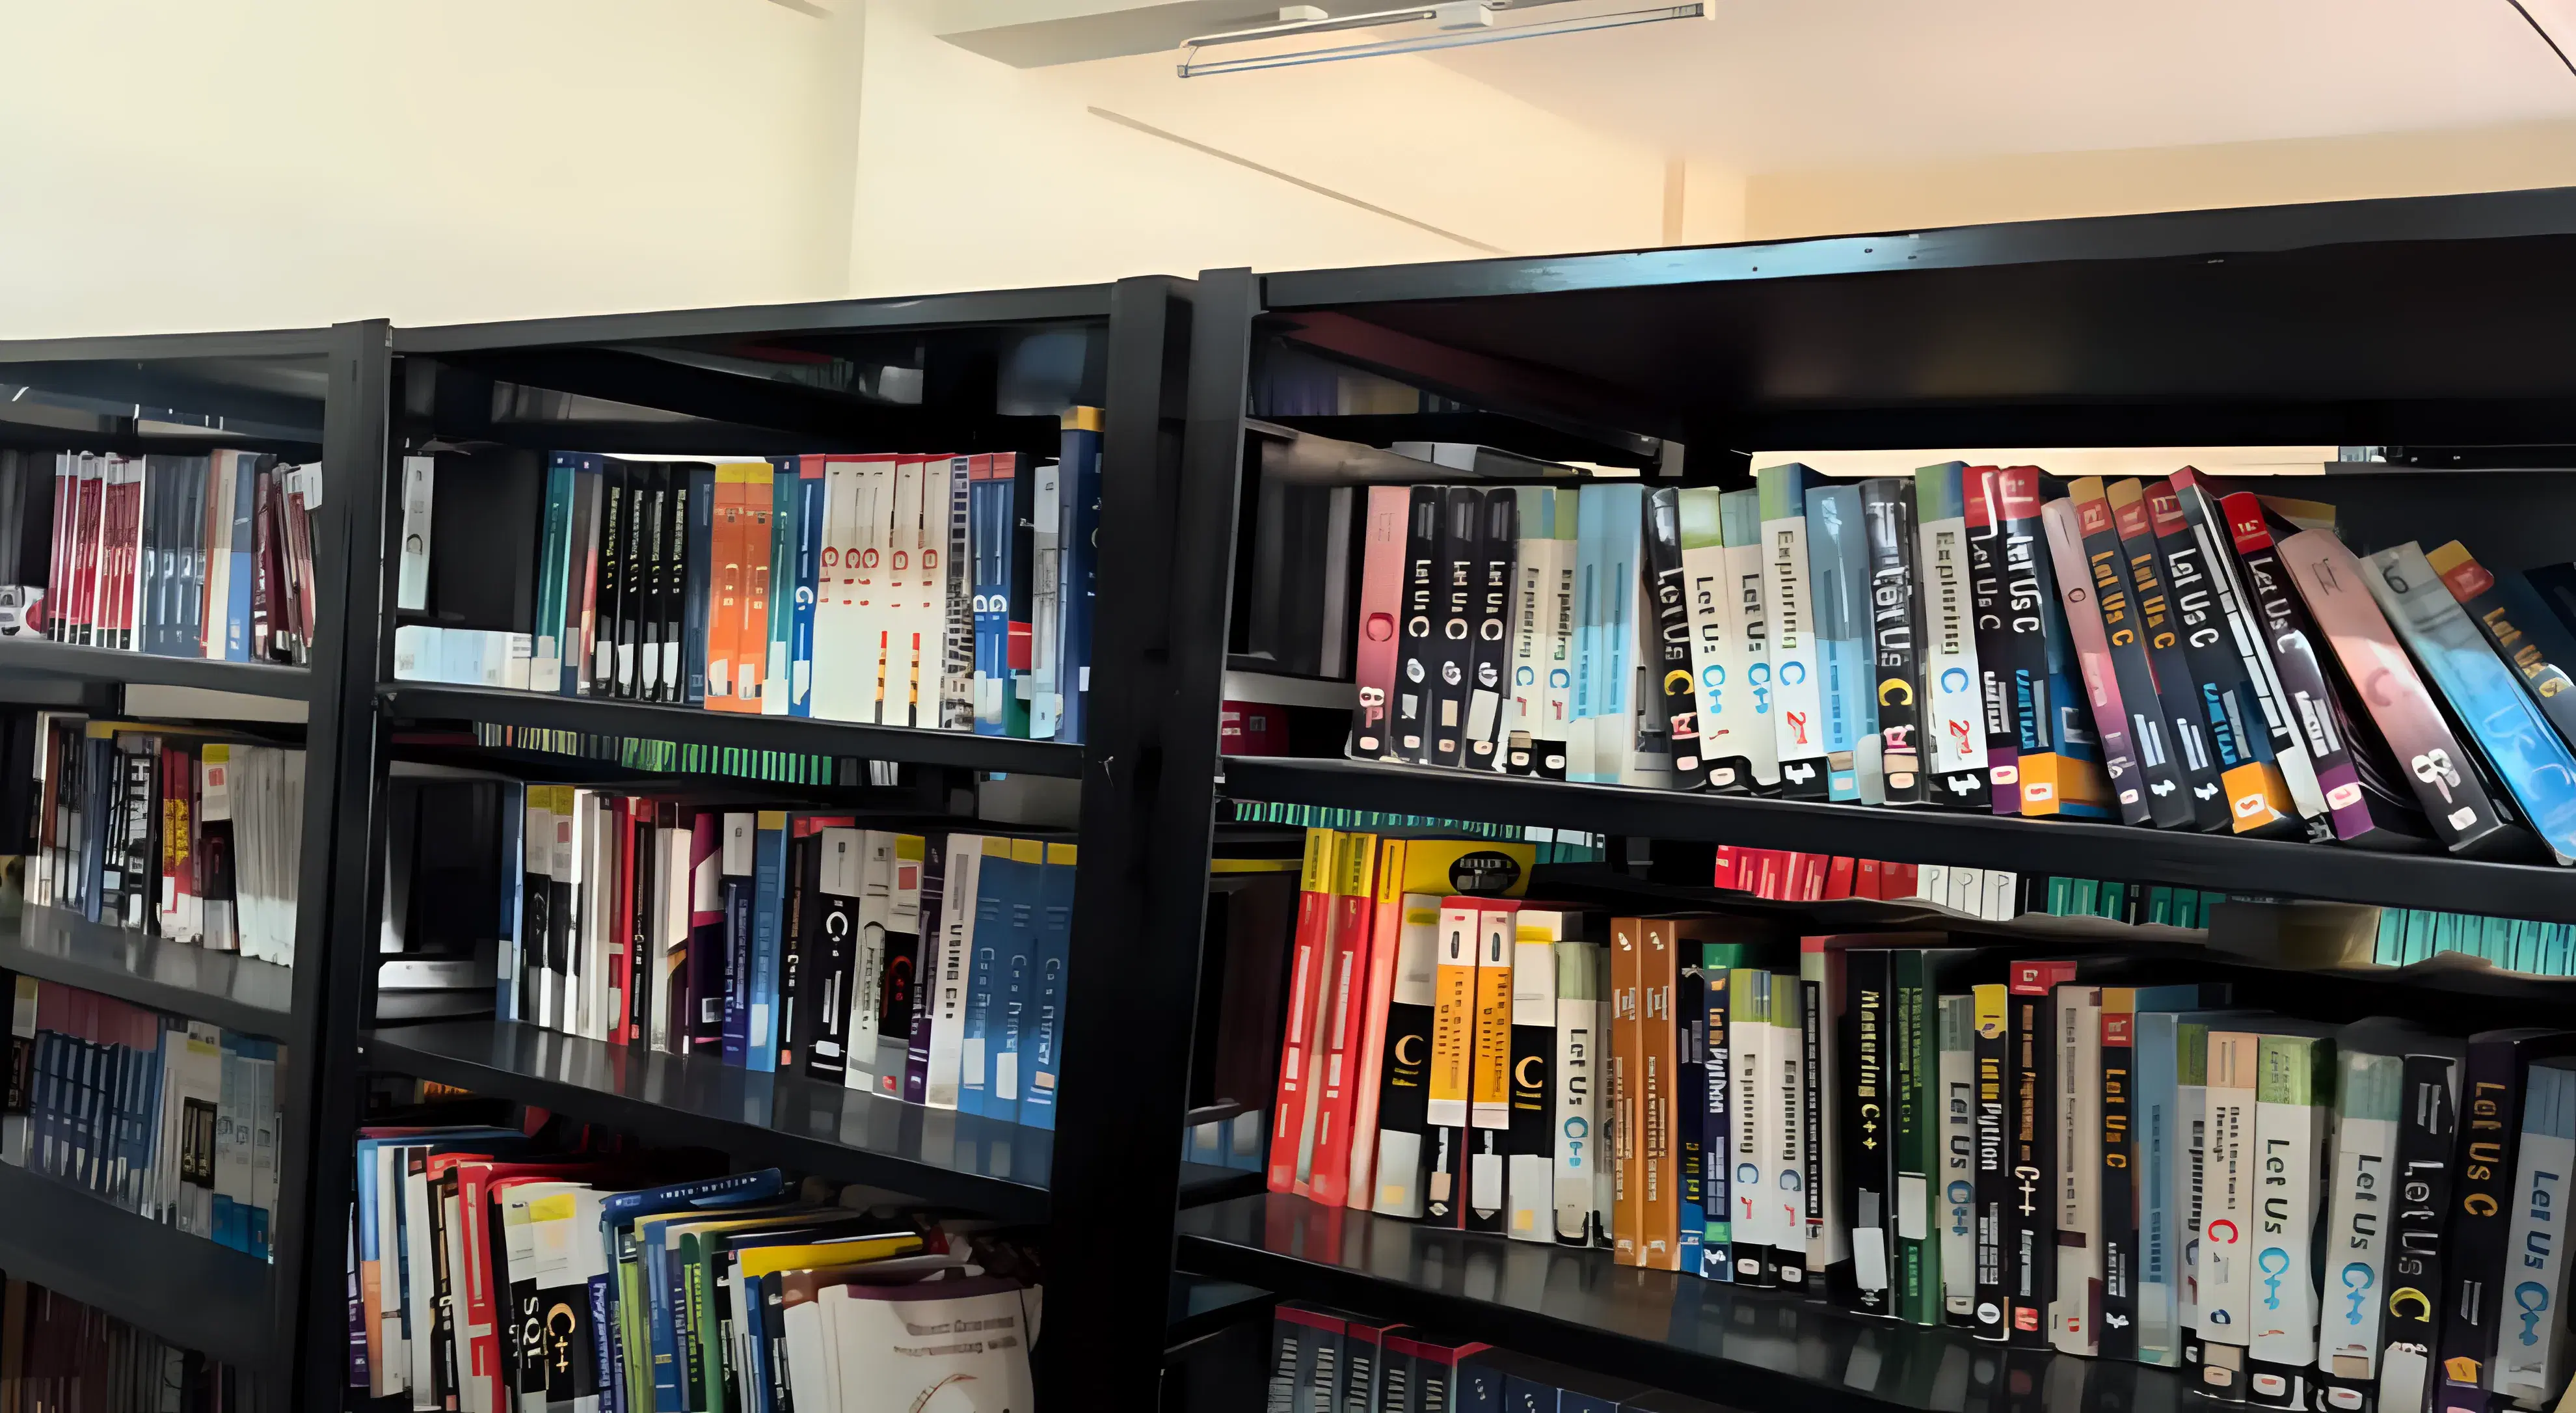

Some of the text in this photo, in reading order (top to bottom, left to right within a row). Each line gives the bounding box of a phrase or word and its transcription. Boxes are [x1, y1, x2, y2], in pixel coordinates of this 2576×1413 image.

[1979, 615, 2001, 630] C
[2013, 617, 2039, 634] C
[2112, 629, 2134, 647] C
[2154, 632, 2176, 649] C
[2189, 628, 2220, 648] C
[1516, 666, 1534, 686] C
[1550, 668, 1570, 689] C
[1664, 669, 1694, 696] C
[1779, 661, 1805, 686] C
[1941, 667, 1969, 693] C
[1879, 678, 1913, 706] C
[1861, 1103, 1879, 1150] C++
[2106, 1153, 2127, 1168] C
[2266, 1138, 2290, 1185] Let
[2463, 1081, 2506, 1218] Let Us C
[1737, 1163, 1758, 1184] C
[1780, 1169, 1801, 1191] C
[2355, 1154, 2382, 1200] Let
[2015, 1166, 2039, 1216] C++
[2530, 1170, 2559, 1222] Let
[2264, 1198, 2287, 1235] Us
[2208, 1218, 2238, 1245] C
[2351, 1213, 2378, 1250] Us
[2389, 1160, 2443, 1323] Let Us C
[2524, 1231, 2550, 1270] Us
[522, 1297, 543, 1368] SQL
[547, 1303, 575, 1373] C++
